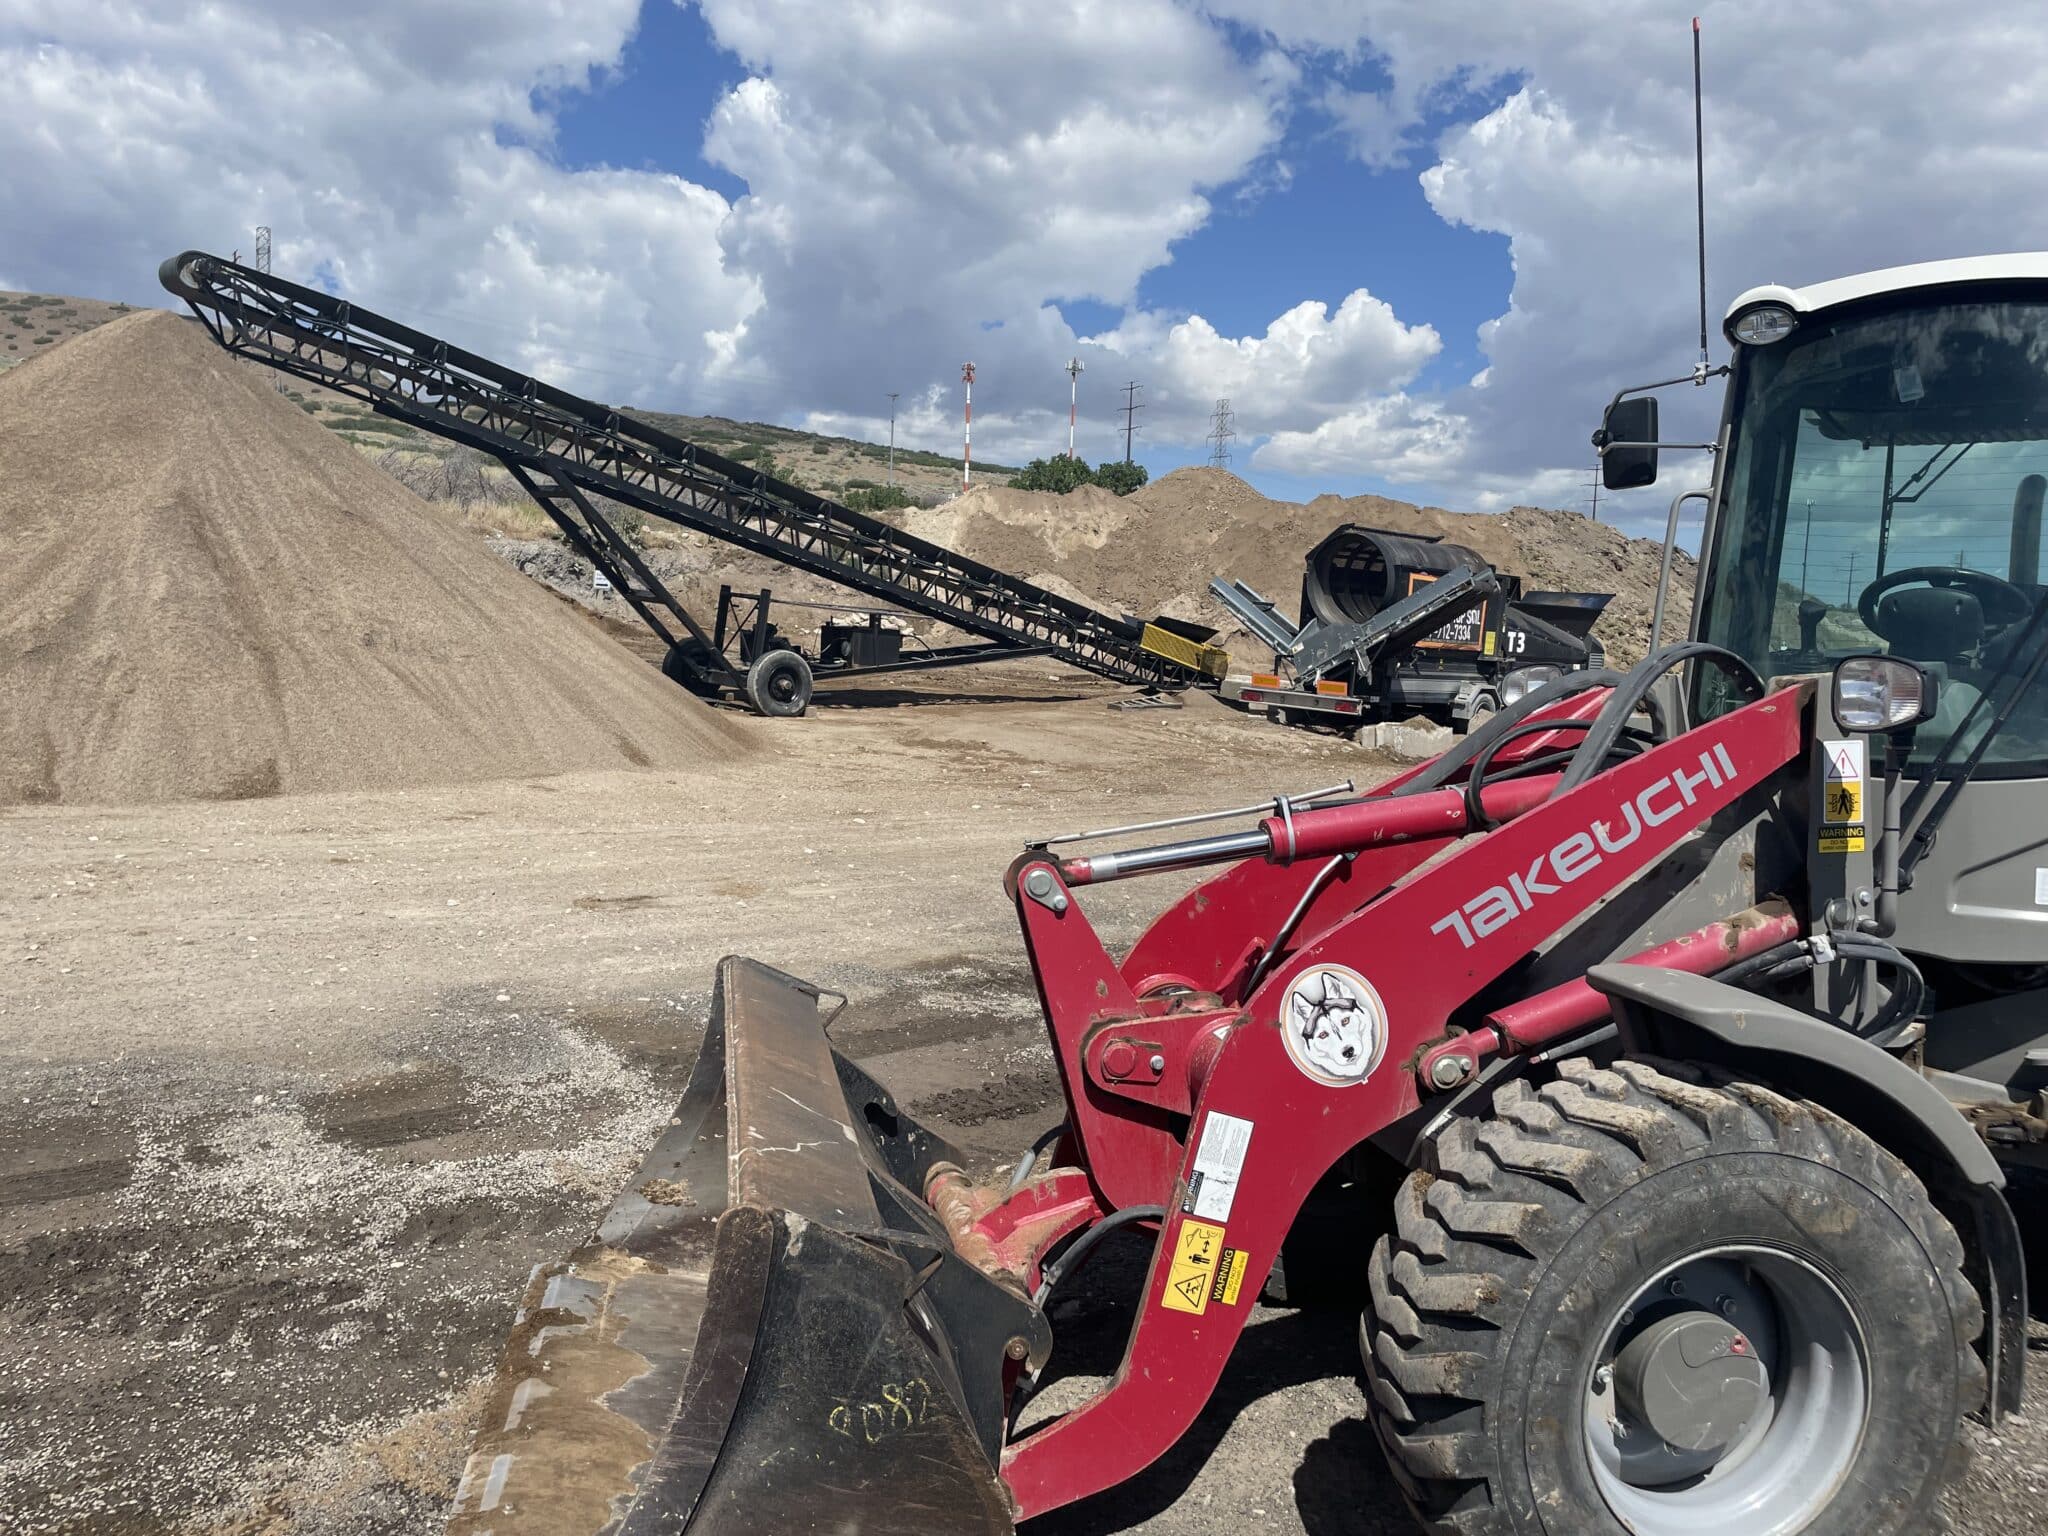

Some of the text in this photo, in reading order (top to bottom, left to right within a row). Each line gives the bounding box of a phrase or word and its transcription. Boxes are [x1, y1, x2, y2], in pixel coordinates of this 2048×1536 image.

[1507, 631, 1526, 653] T3
[1820, 827, 1863, 837] WARNING
[1212, 1249, 1234, 1300] WARNING
